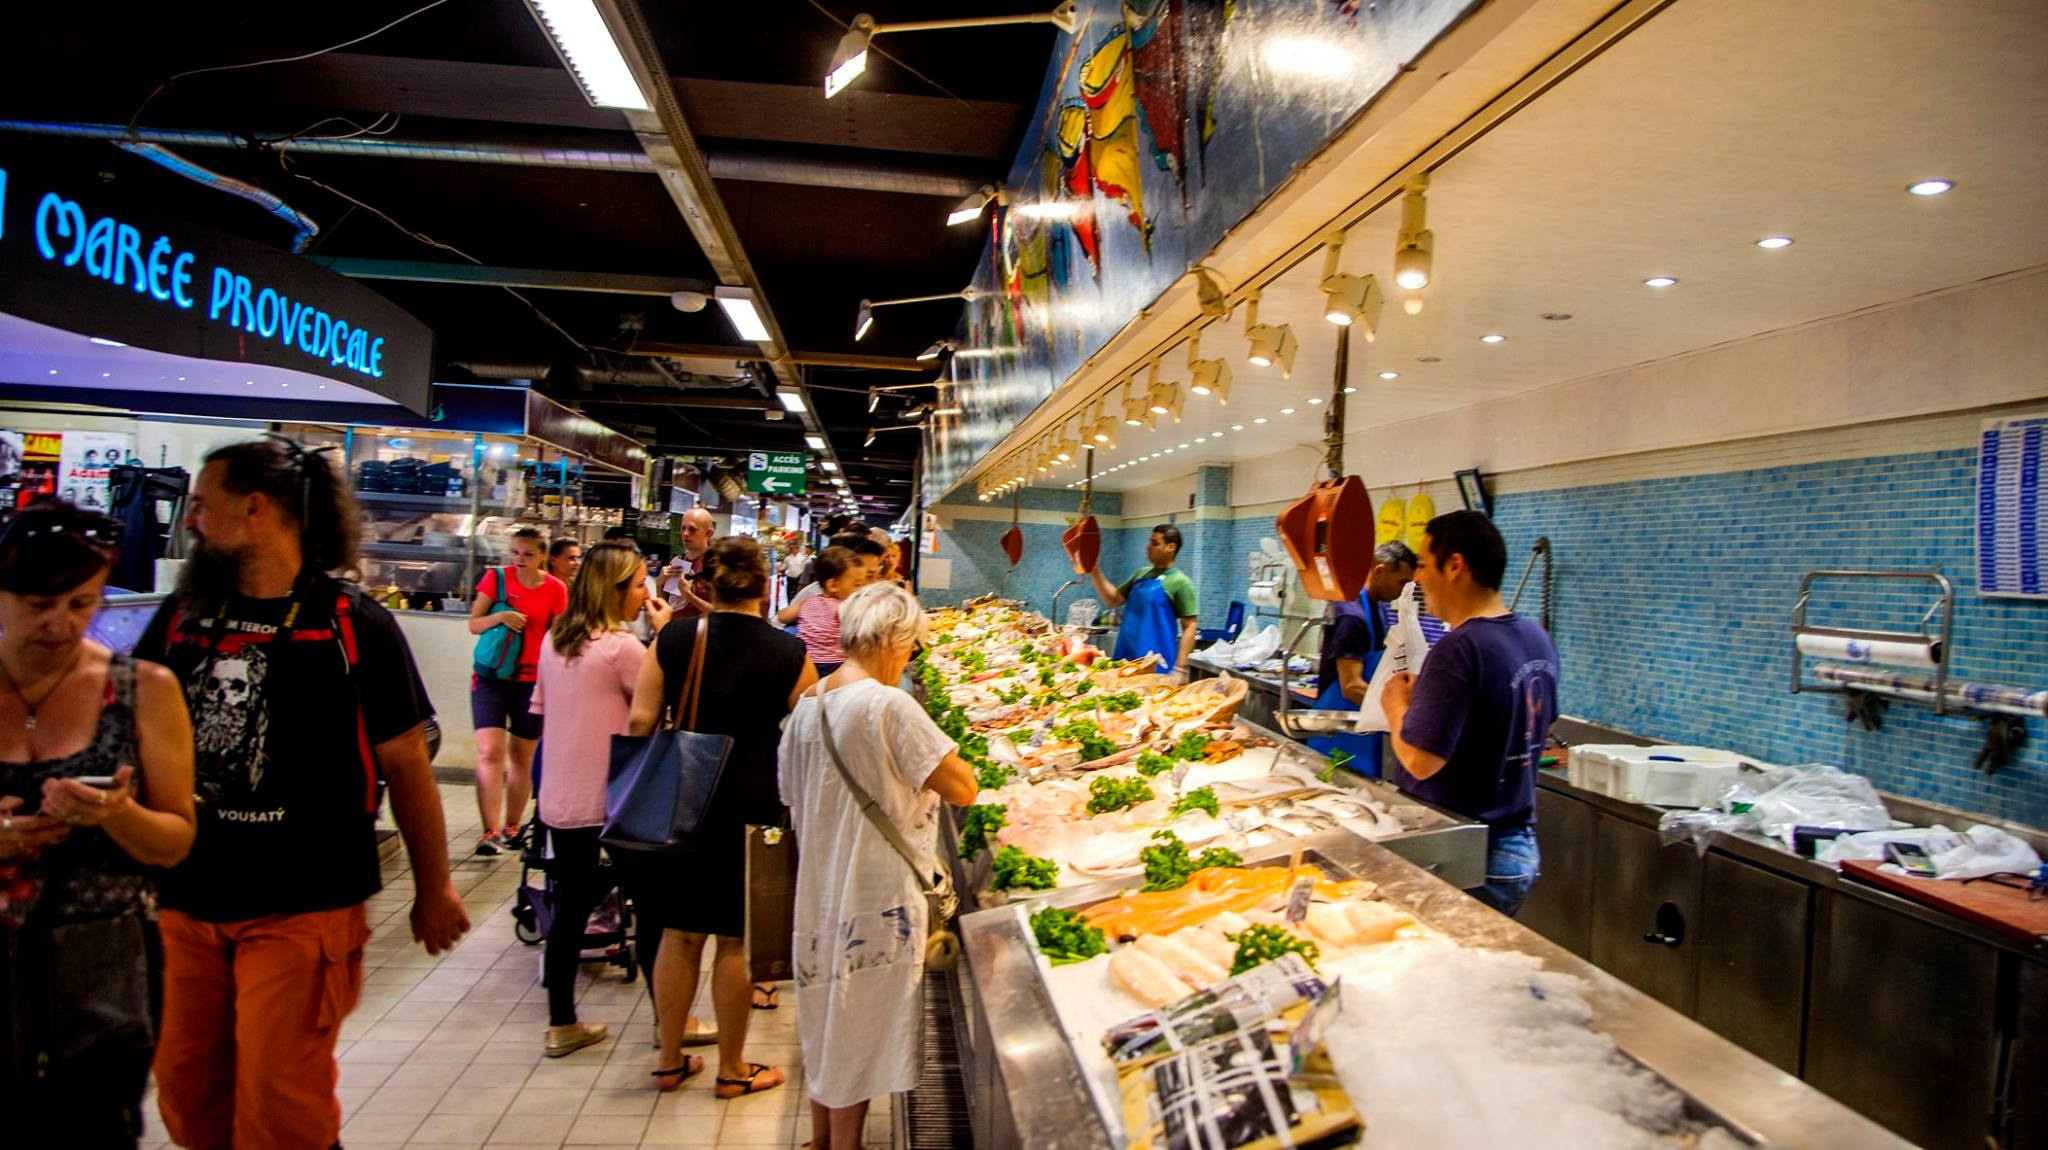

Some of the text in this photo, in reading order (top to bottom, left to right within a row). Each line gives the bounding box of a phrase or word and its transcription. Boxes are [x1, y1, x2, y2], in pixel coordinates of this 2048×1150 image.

[35, 192, 195, 308] MARÉE
[209, 266, 385, 378] PROVENÇALE
[767, 465, 805, 474] PARKING
[218, 808, 285, 822] VOUSATÝ
